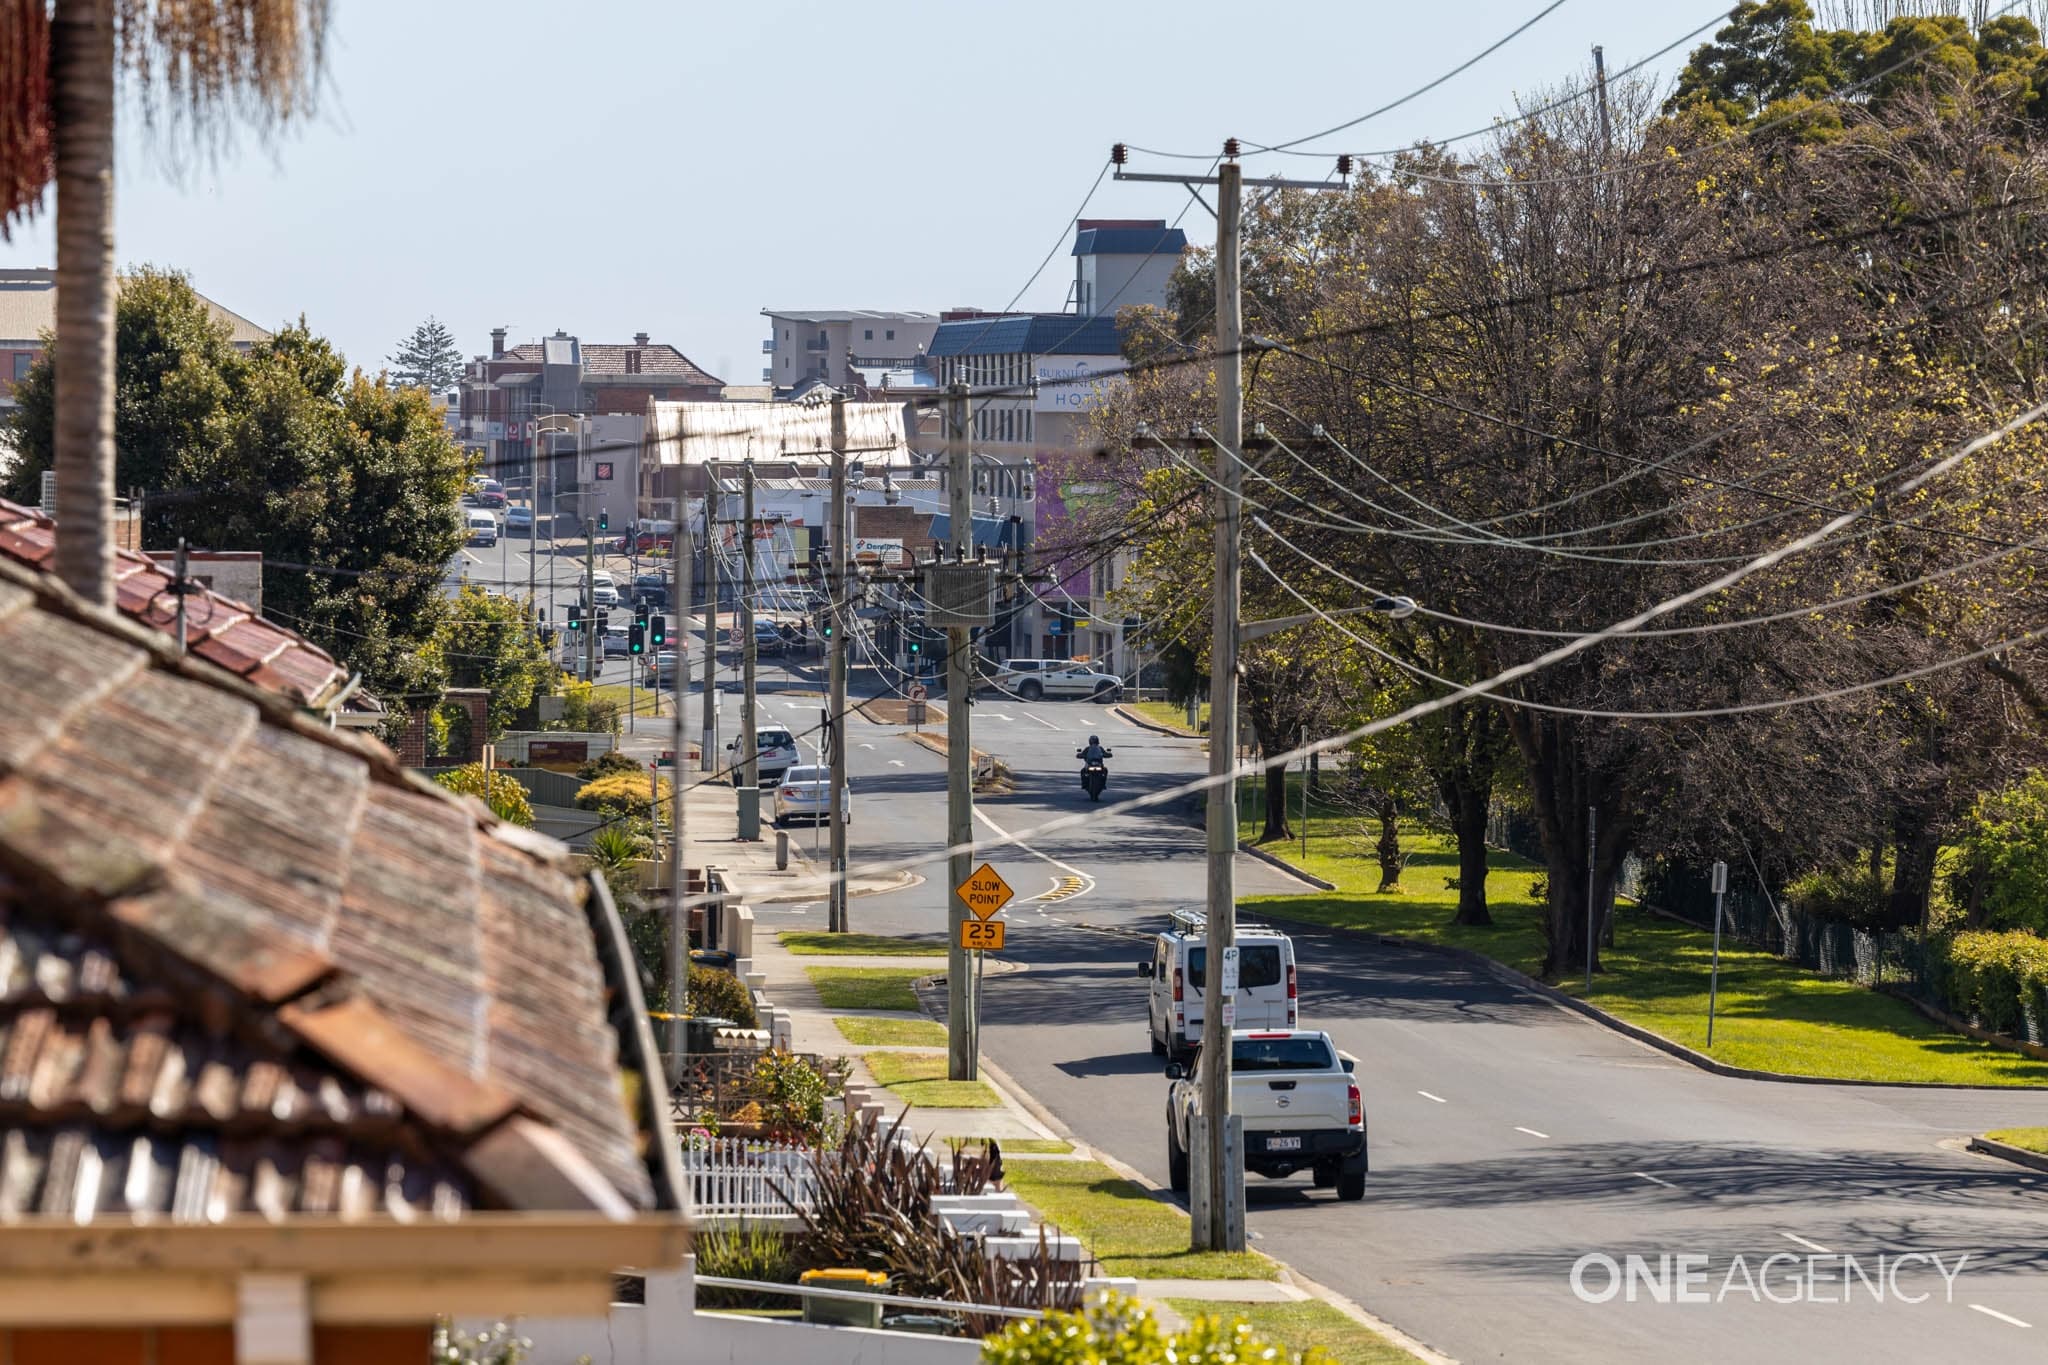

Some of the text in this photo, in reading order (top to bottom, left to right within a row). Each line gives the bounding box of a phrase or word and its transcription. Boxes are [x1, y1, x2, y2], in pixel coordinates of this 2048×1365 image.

[971, 880, 1000, 891] SLOW
[969, 893, 1000, 904] POINT
[969, 923, 996, 939] 25
[1224, 950, 1238, 961] 4P
